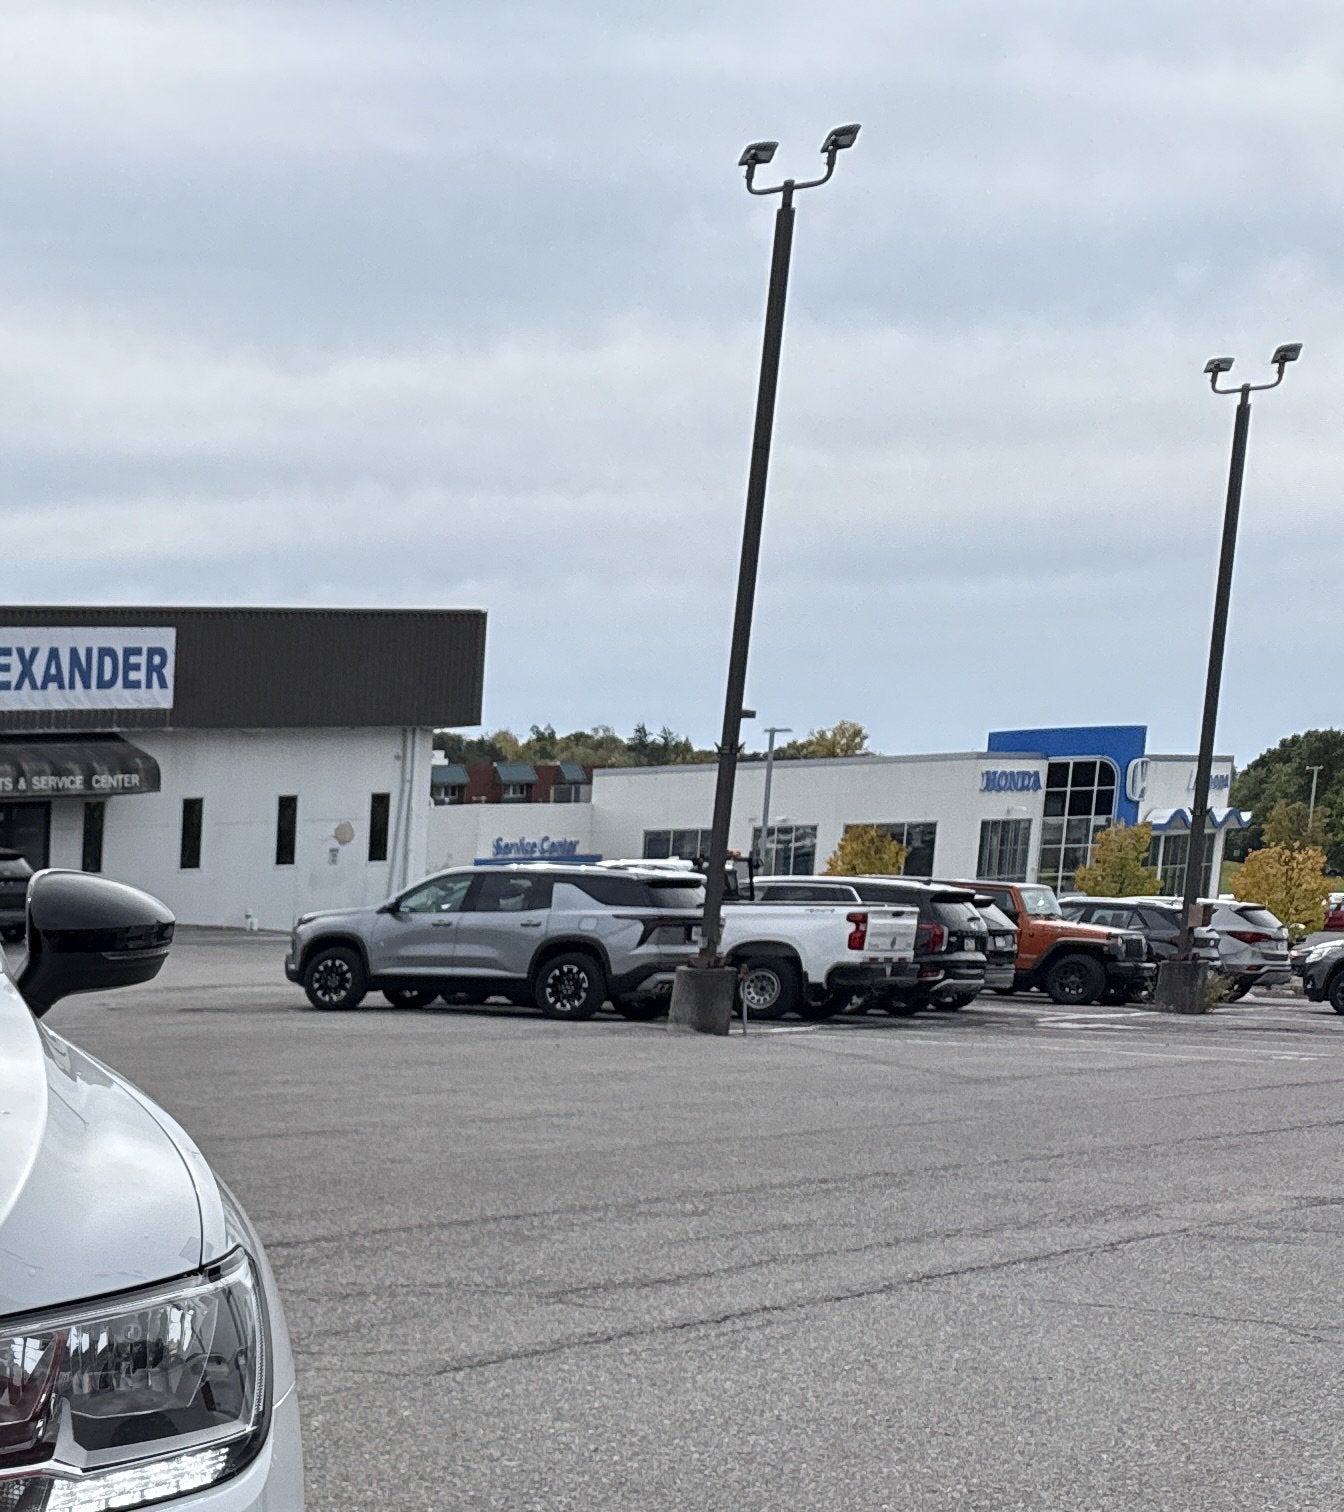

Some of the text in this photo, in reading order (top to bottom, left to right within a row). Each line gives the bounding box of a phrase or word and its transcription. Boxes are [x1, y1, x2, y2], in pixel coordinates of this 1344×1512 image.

[17, 777, 27, 790] &
[31, 776, 84, 790] SERVICE
[92, 774, 140, 788] CENTER
[981, 770, 1042, 791] HONDA
[493, 835, 579, 857] Service Center
